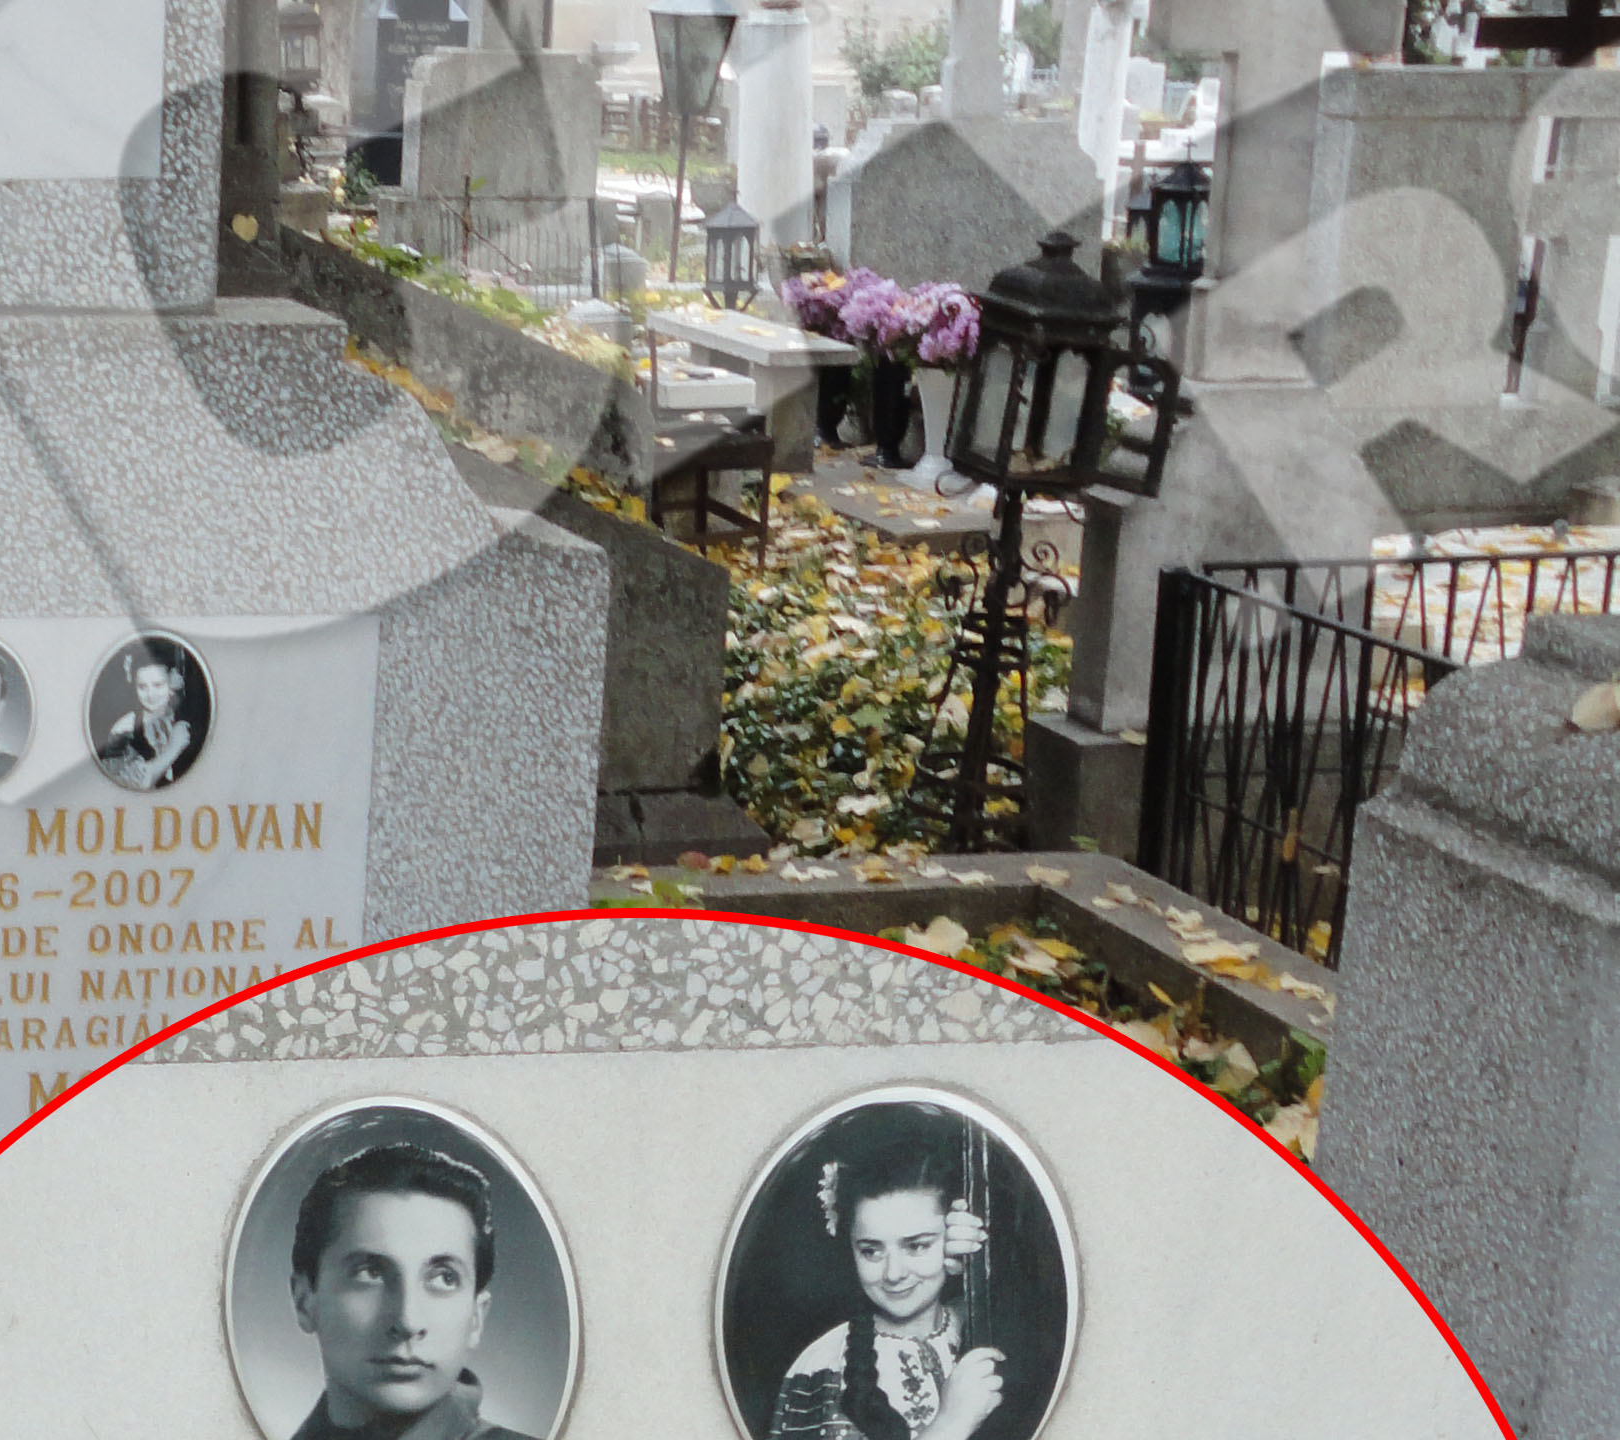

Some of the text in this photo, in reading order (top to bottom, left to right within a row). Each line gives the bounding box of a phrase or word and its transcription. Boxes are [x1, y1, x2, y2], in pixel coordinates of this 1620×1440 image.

[26, 803, 324, 857] MOLDOVAN
[1, 927, 59, 959] DE
[88, 919, 266, 957] ONOARE
[294, 917, 348, 950] AL
